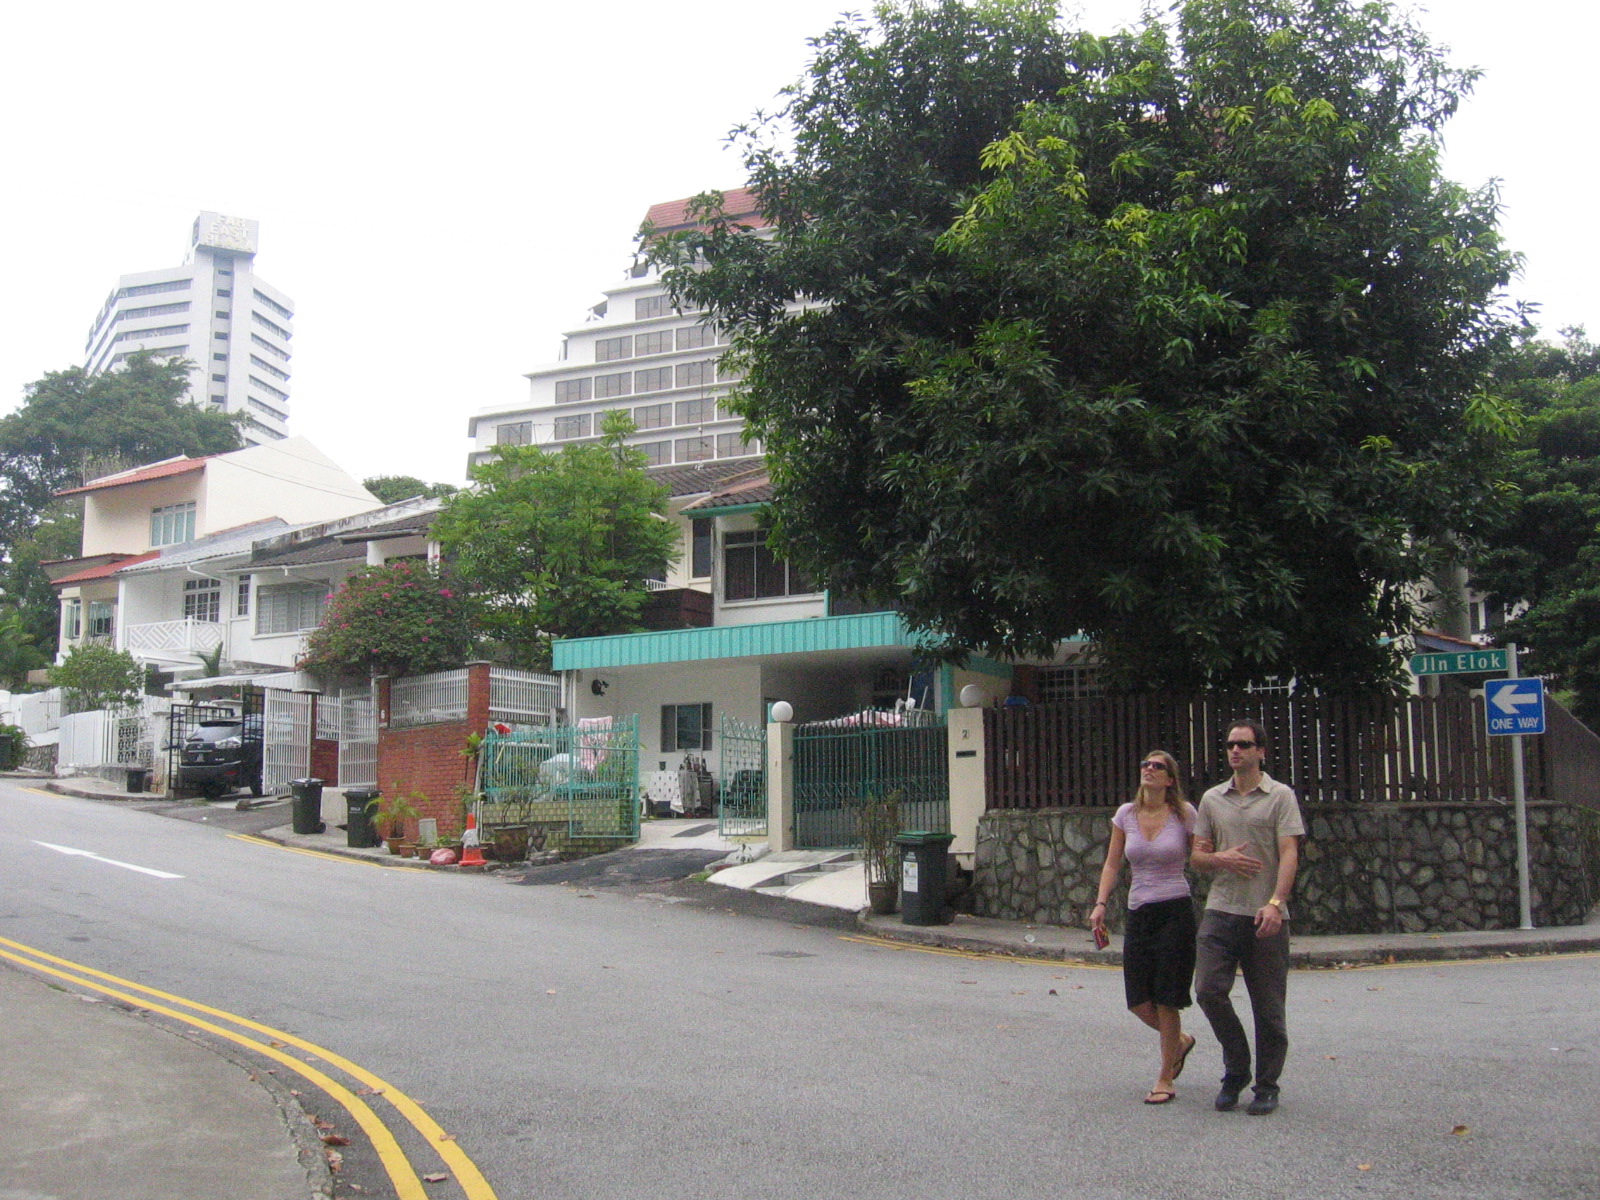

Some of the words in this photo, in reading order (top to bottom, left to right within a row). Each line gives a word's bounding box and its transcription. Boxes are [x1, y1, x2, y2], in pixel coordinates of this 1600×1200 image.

[217, 215, 245, 227] FAR
[210, 222, 249, 238] EAST
[1420, 656, 1448, 672] Jln
[1457, 653, 1501, 670] Elok
[1491, 718, 1513, 730] ONE
[1517, 717, 1539, 728] WAY
